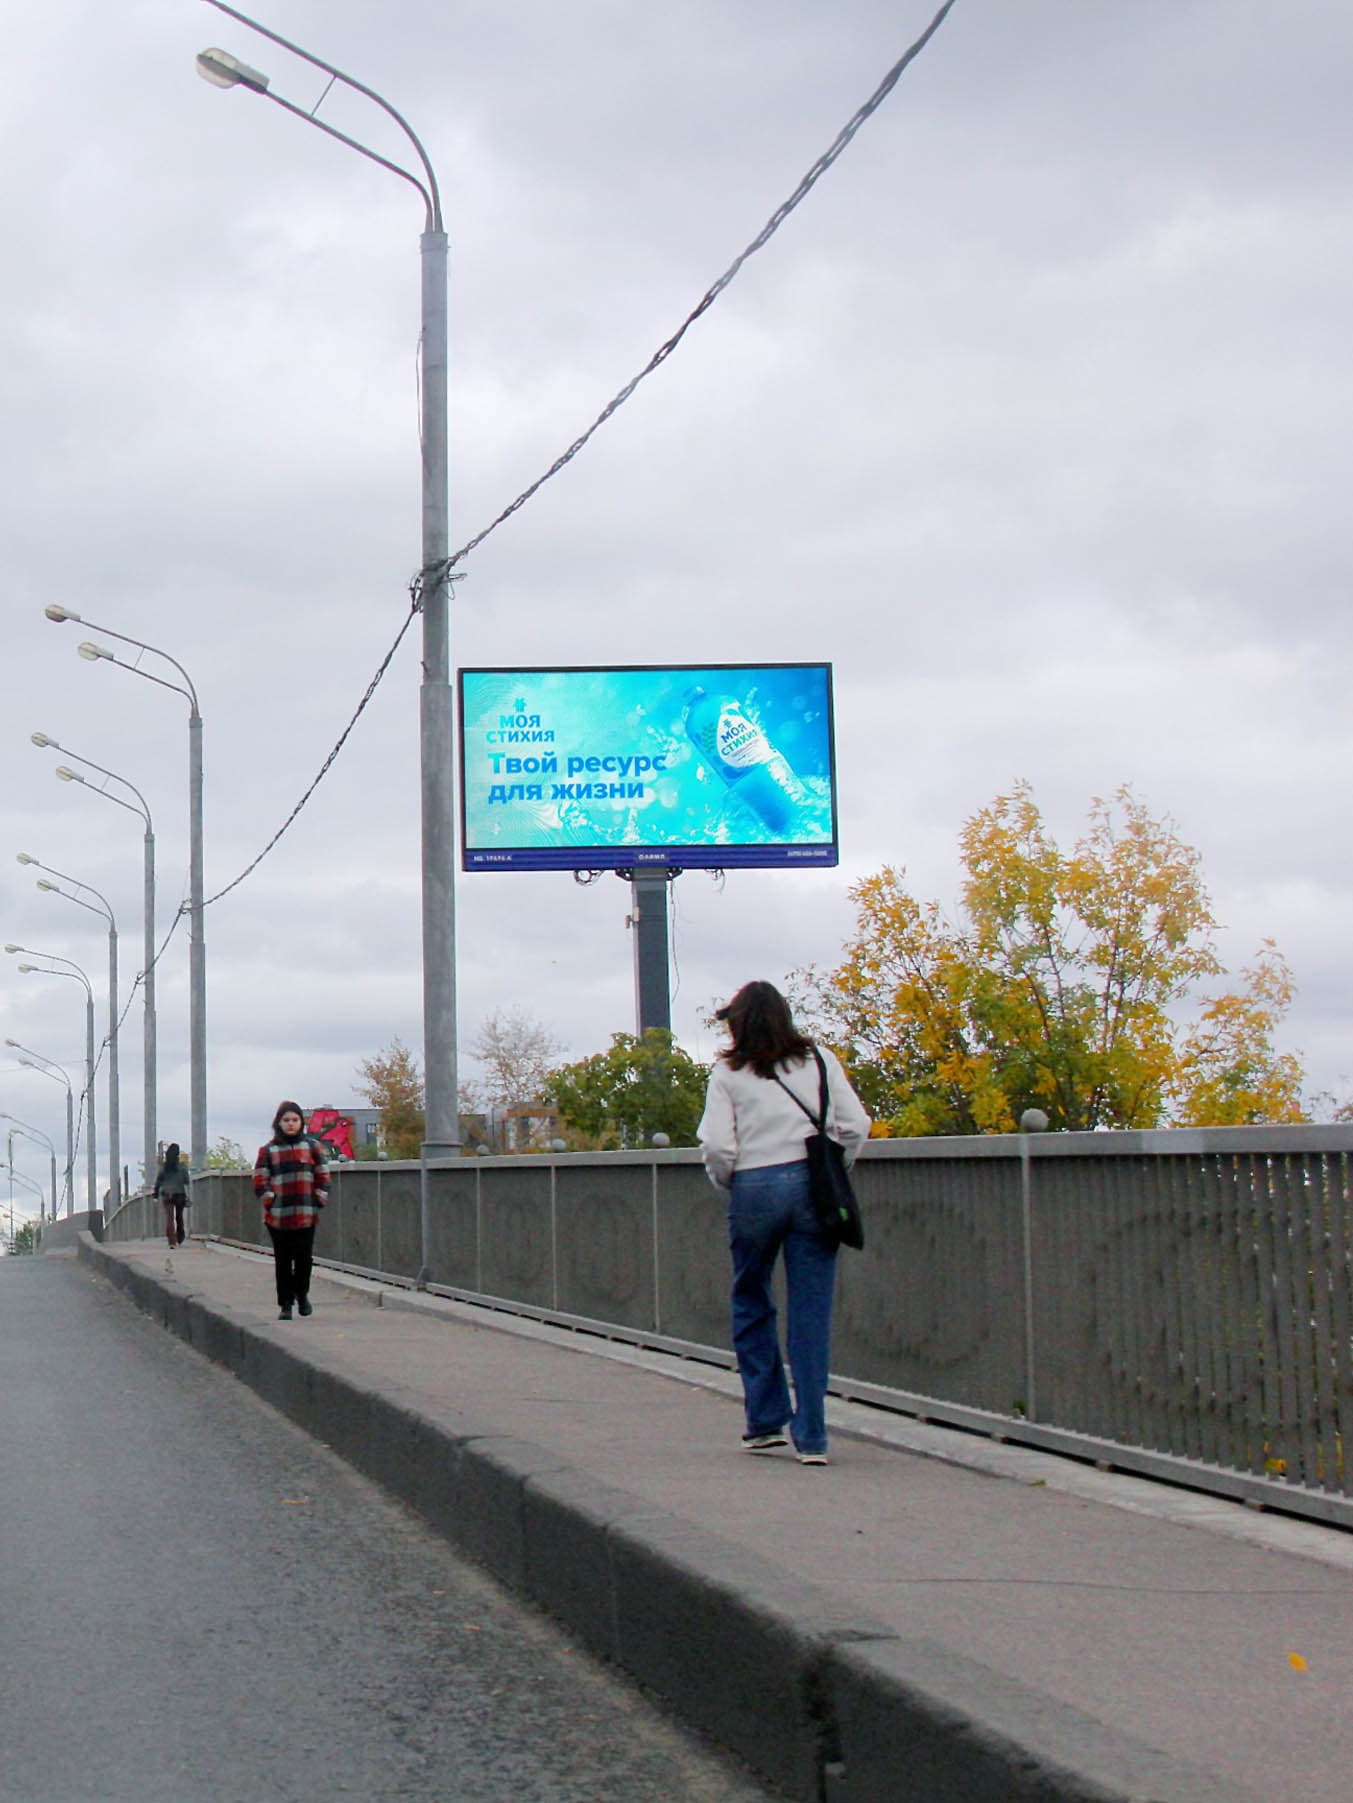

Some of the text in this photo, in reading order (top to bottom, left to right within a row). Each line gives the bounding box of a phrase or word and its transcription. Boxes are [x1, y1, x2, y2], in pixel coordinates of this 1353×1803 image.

[500, 714, 541, 729] МОЯ
[486, 730, 555, 744] СТИХИЯ
[721, 723, 747, 743] МОЯ
[487, 751, 668, 778] Твой ресурс
[488, 782, 644, 804] для жизни
